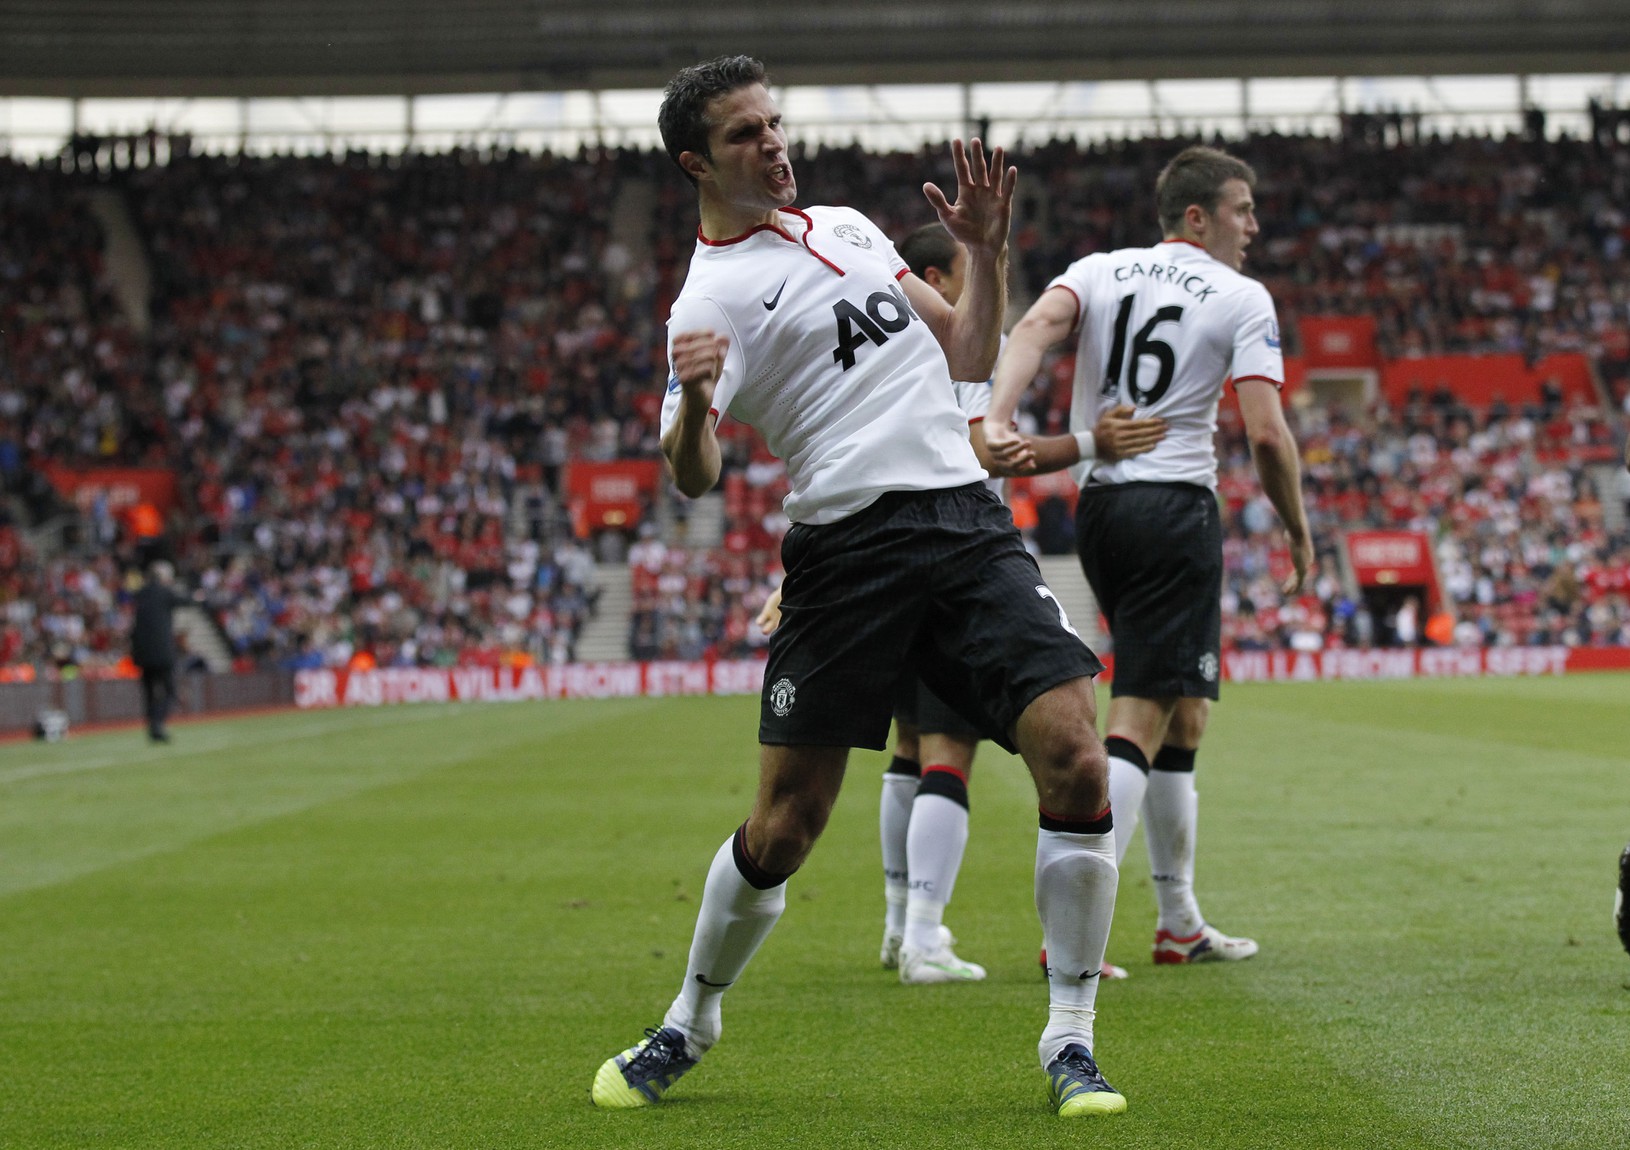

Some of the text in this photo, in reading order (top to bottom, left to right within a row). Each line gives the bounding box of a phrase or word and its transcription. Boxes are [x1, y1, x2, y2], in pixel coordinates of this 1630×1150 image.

[1114, 262, 1218, 303] CARRICK
[1101, 293, 1185, 408] 16
[345, 667, 448, 706] ASTON
[451, 666, 548, 702] VILLA
[549, 663, 640, 699] FROM
[1225, 651, 1322, 683] VILLA
[1323, 650, 1413, 680] FROM
[1485, 648, 1571, 676] SEPT
